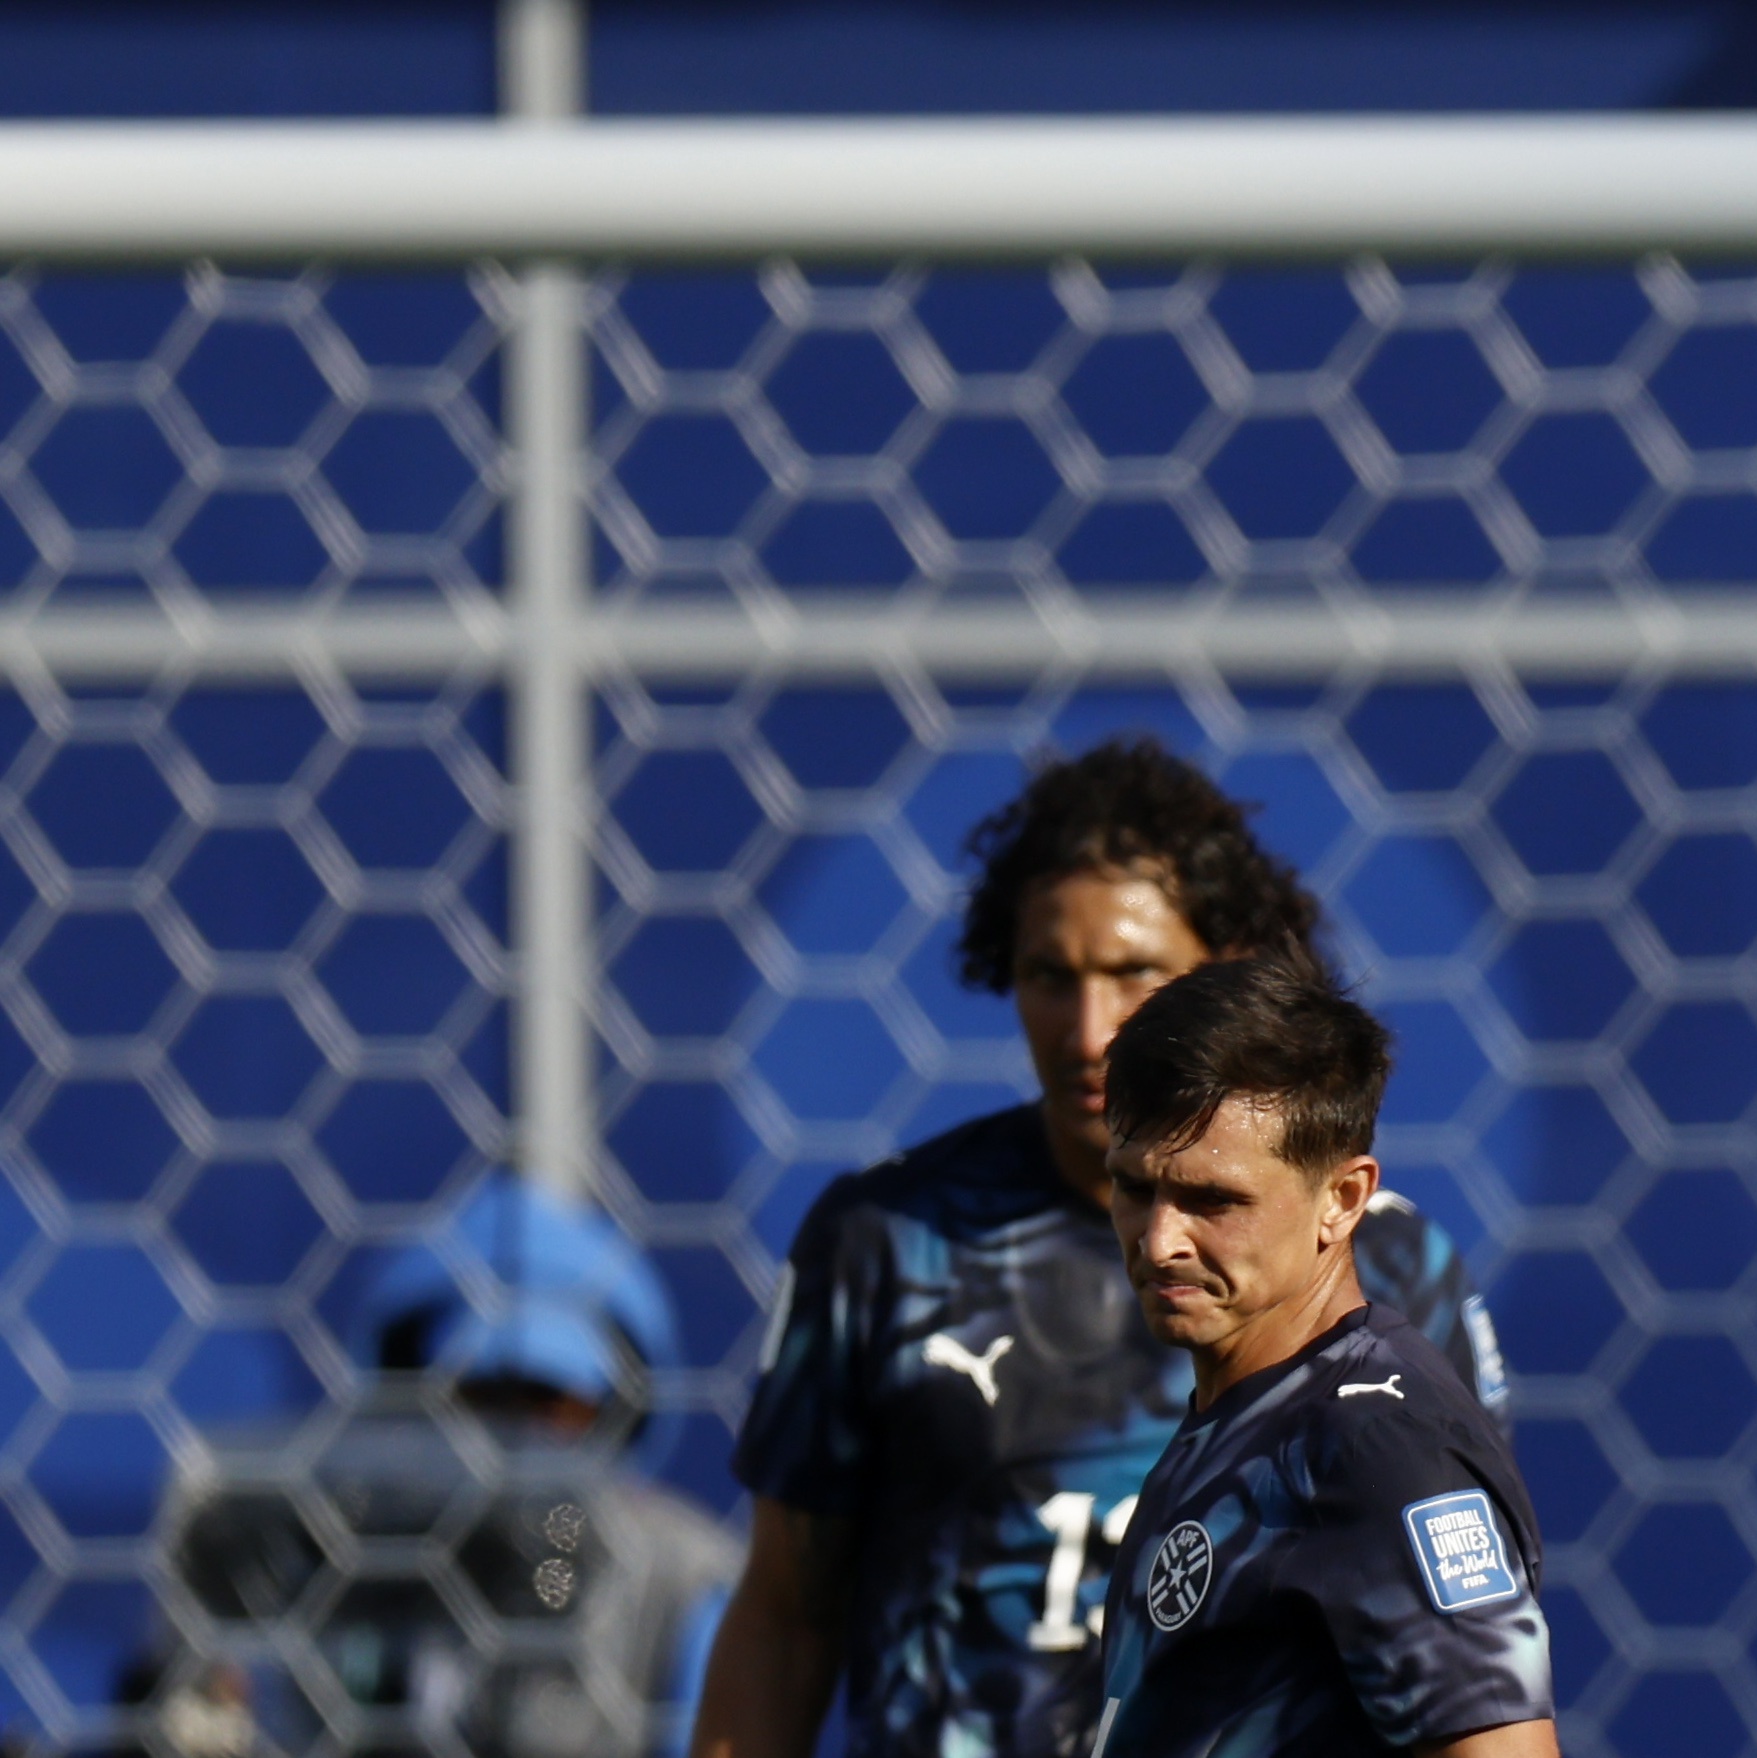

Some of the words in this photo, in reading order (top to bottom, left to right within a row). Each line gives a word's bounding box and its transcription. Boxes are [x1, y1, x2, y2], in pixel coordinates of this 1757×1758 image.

[1425, 1509, 1484, 1536] FOOTBALL
[1177, 1529, 1200, 1549] APF
[1431, 1525, 1491, 1559] UNITES
[1026, 1491, 1140, 1652] 1
[1460, 1549, 1499, 1575] World
[1461, 1574, 1491, 1590] FIFA
